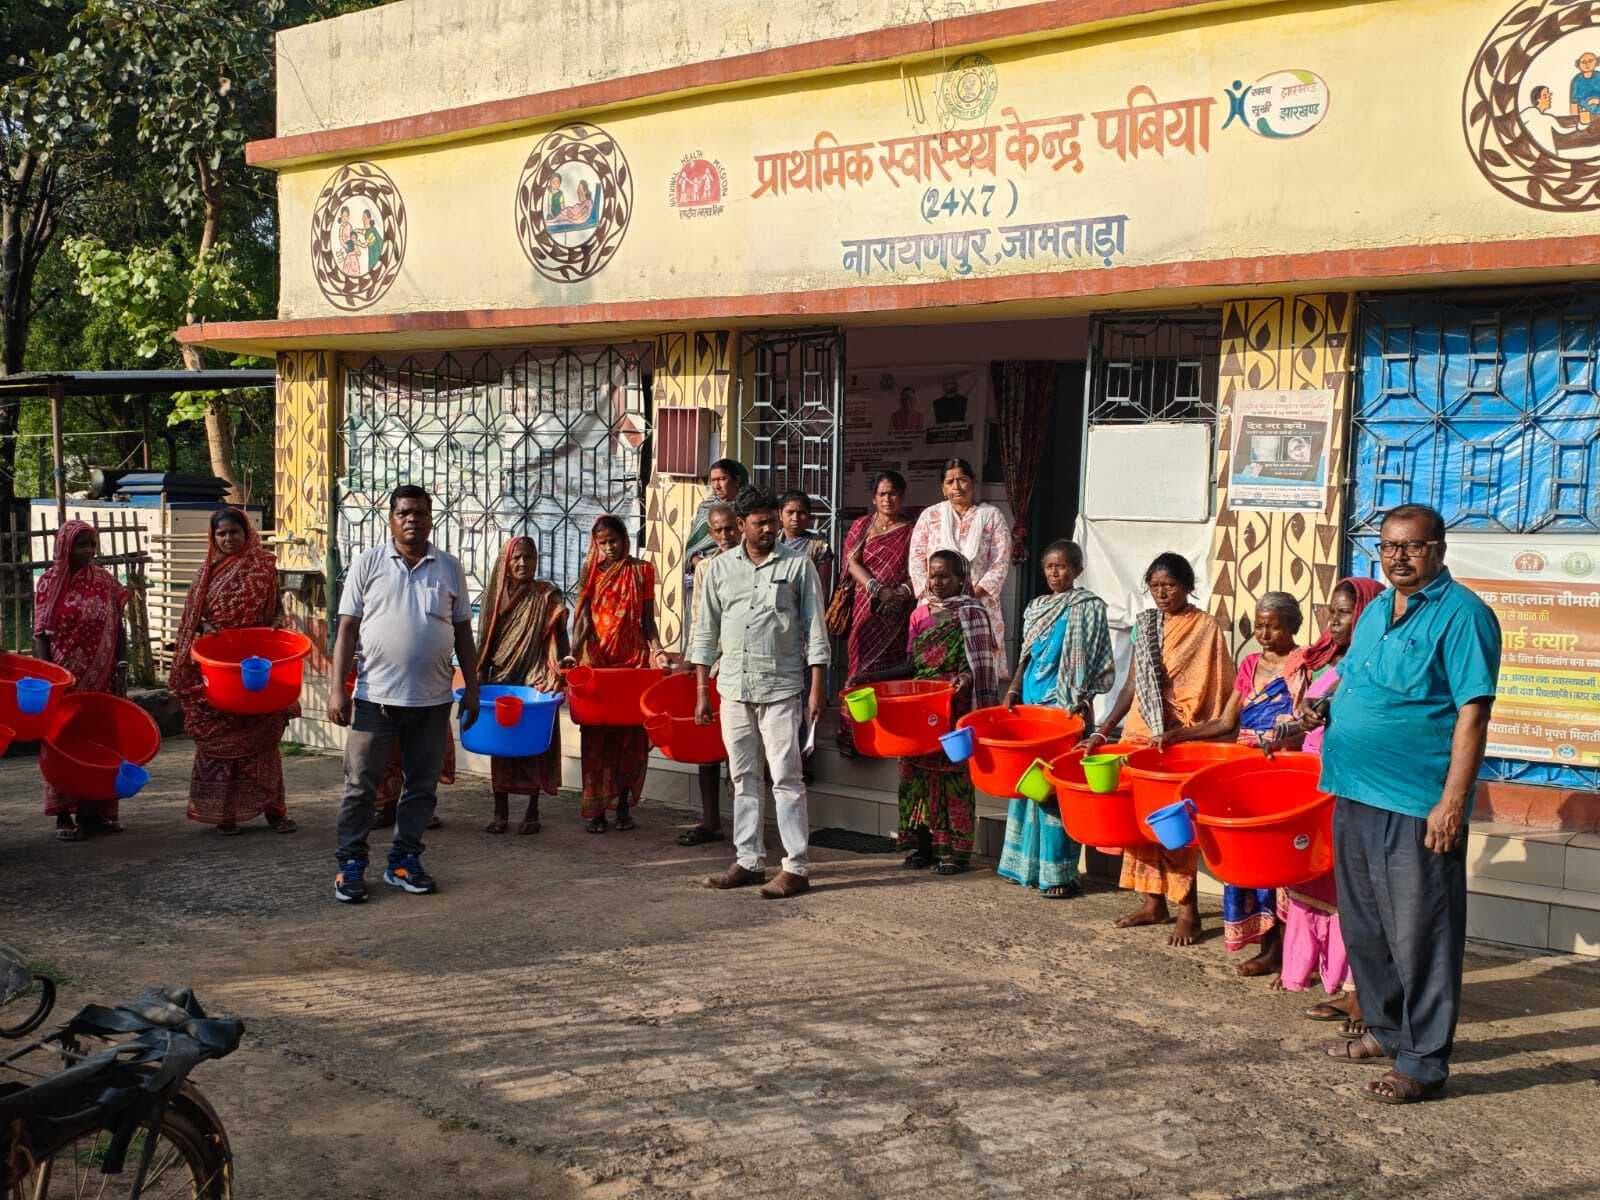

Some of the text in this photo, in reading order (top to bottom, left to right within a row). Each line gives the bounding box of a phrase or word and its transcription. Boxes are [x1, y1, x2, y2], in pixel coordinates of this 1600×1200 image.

[751, 84, 1218, 199] प्राथमिक स्वास्थ्य केन्द्र पबिया
[1500, 592, 1554, 606] लाइलाज
[1556, 590, 1600, 608] बीमारी
[1531, 632, 1579, 652] क्या?
